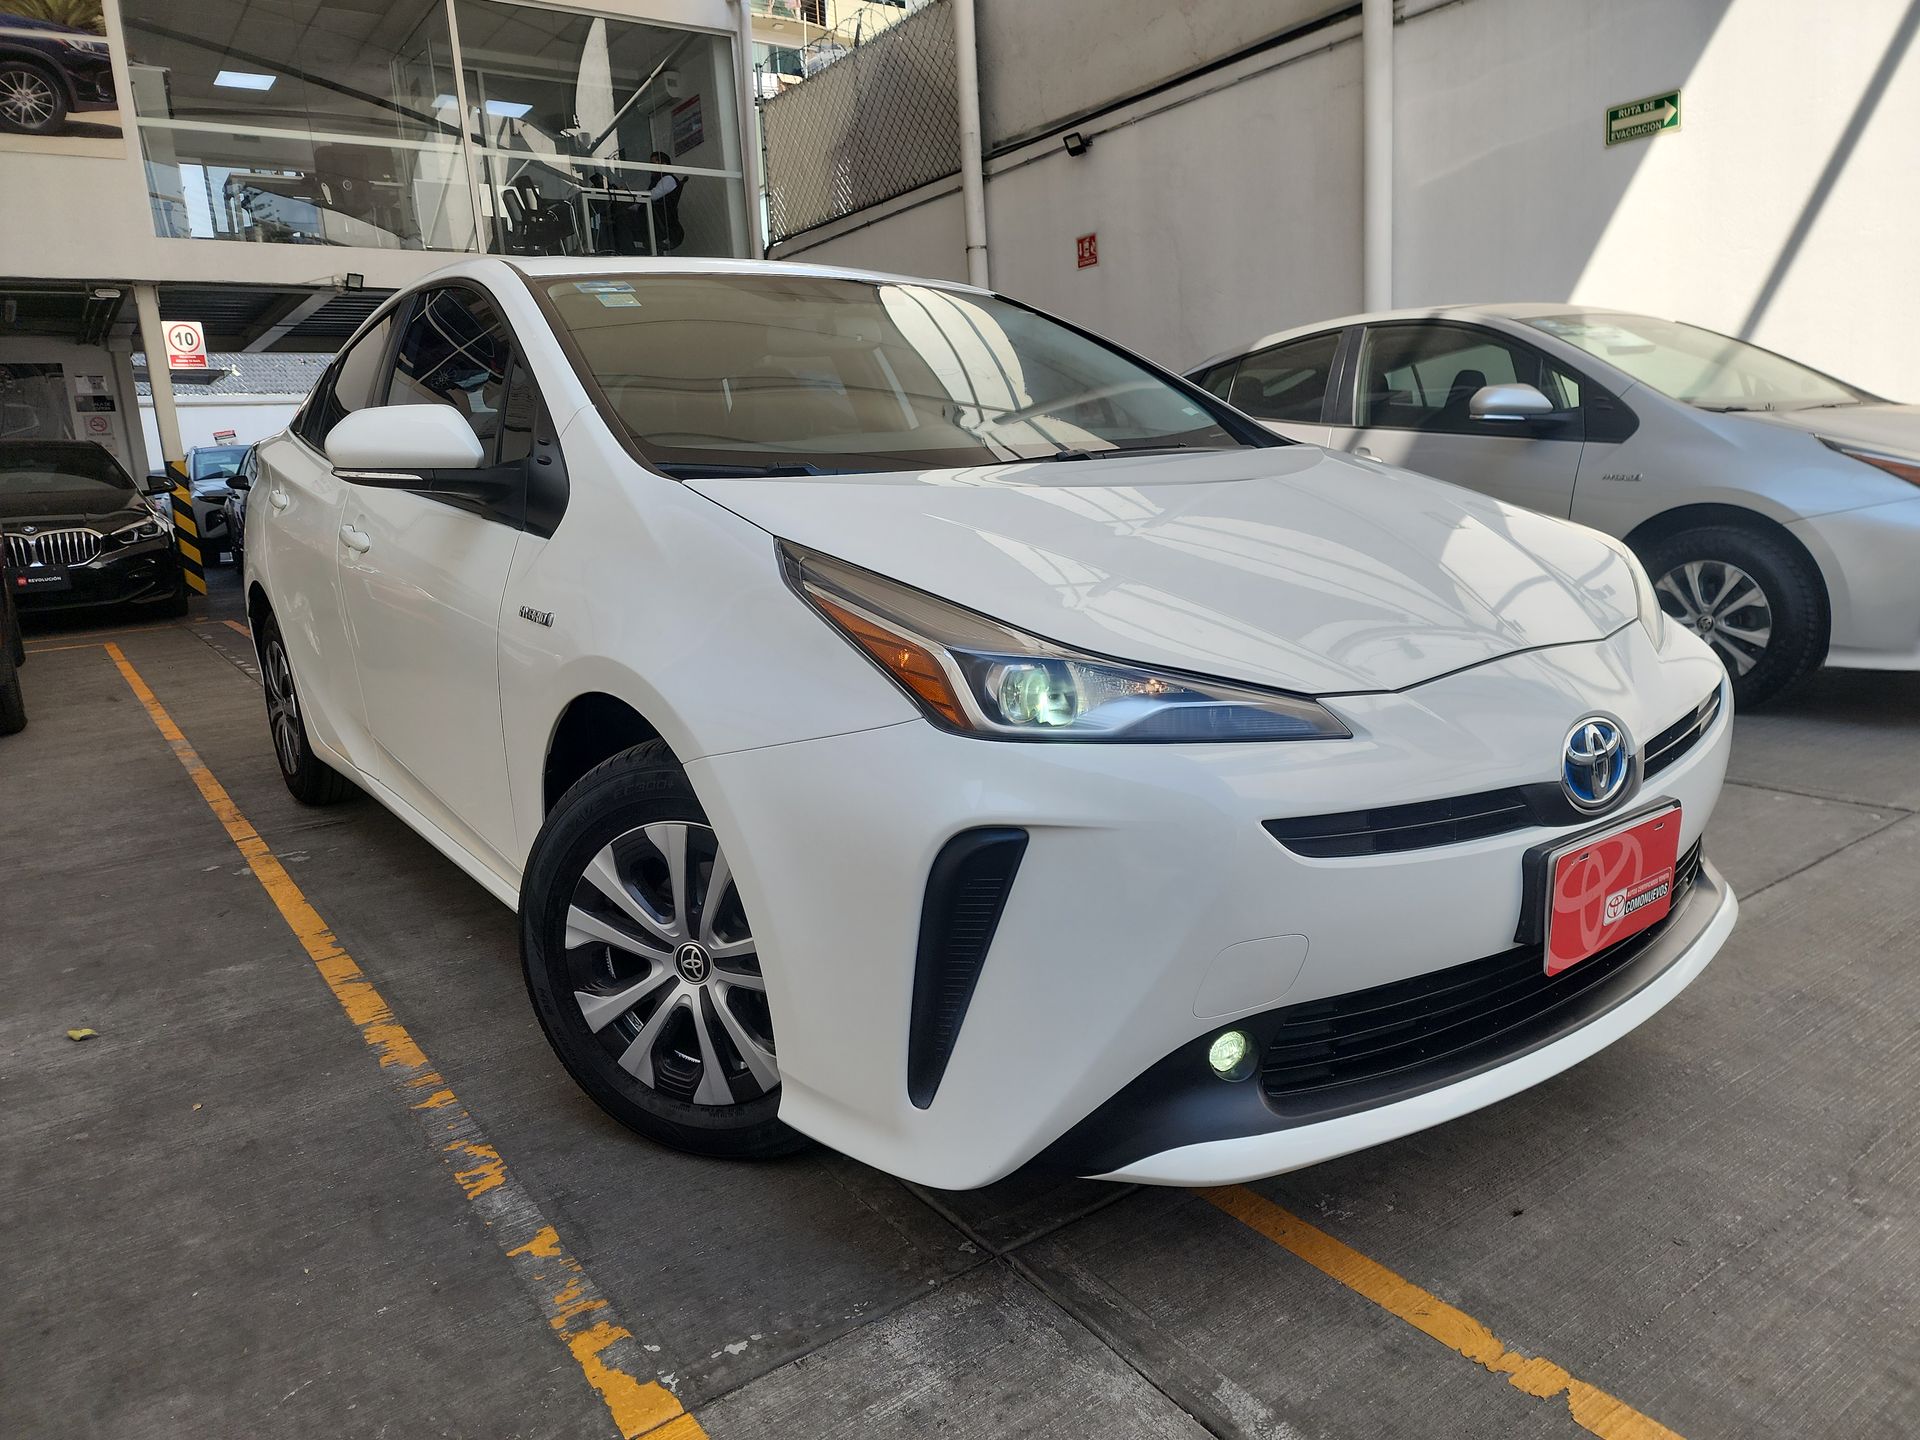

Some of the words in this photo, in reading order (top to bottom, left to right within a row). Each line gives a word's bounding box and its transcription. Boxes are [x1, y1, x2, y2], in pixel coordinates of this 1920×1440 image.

[1618, 105, 1641, 118] RUTA
[1643, 101, 1655, 112] DE
[175, 332, 194, 346] 10
[1625, 883, 1669, 913] COMONUEVOS
